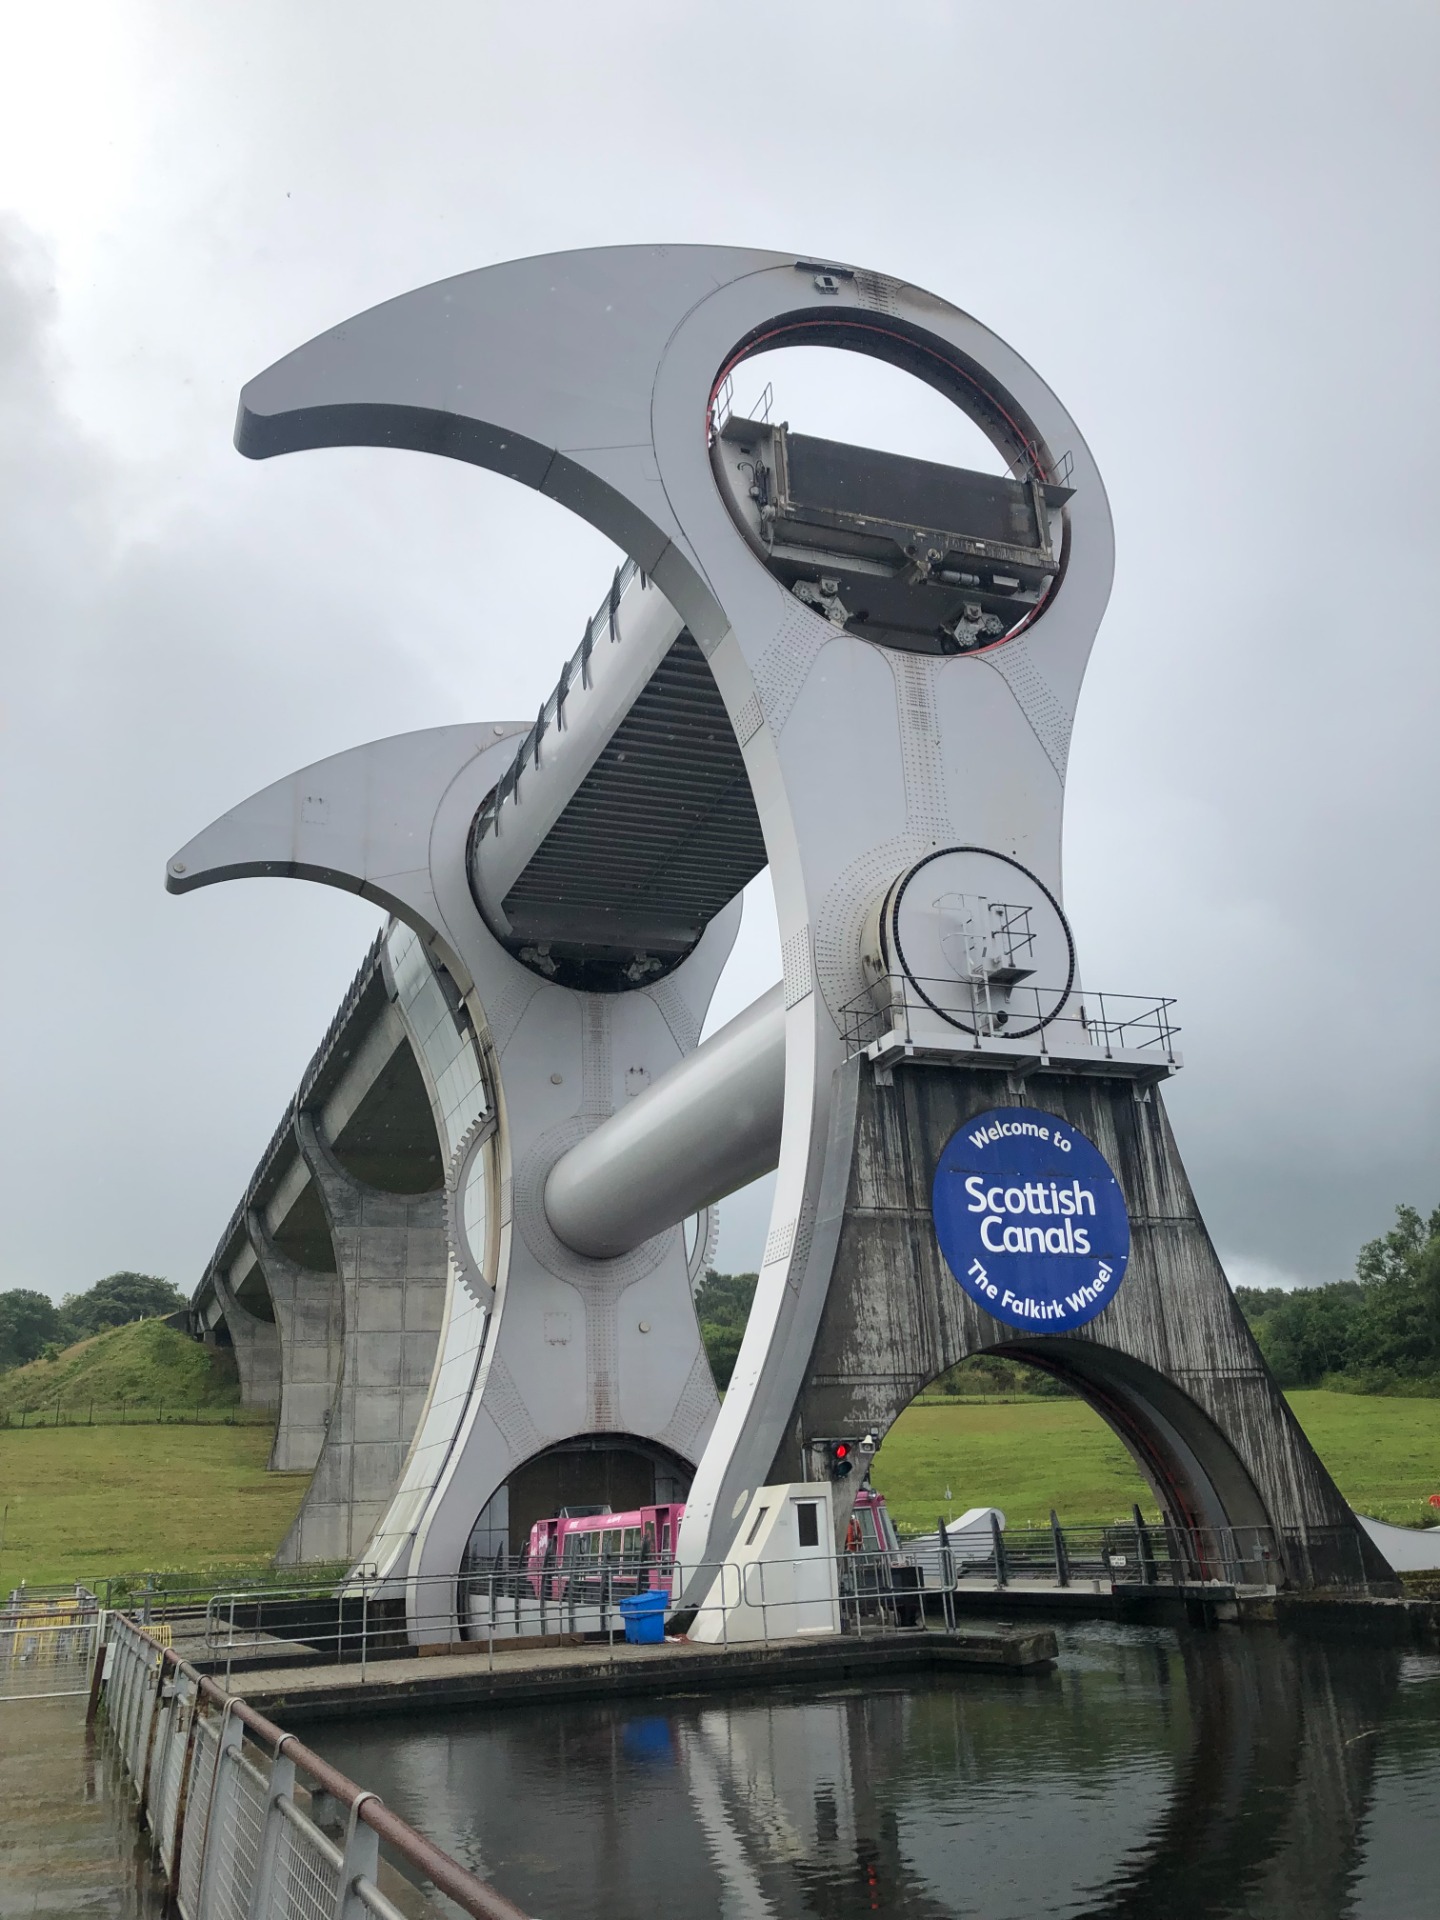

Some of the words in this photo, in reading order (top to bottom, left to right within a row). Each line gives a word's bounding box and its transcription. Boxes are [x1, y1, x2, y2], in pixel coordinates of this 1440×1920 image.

[968, 1120, 1049, 1149] Welcome
[1054, 1131, 1072, 1152] to
[965, 1176, 1096, 1216] Scottish
[980, 1215, 1091, 1254] Canals
[967, 1258, 998, 1299] The
[1001, 1289, 1066, 1319] Falkirk
[1065, 1260, 1113, 1312] Wheel
